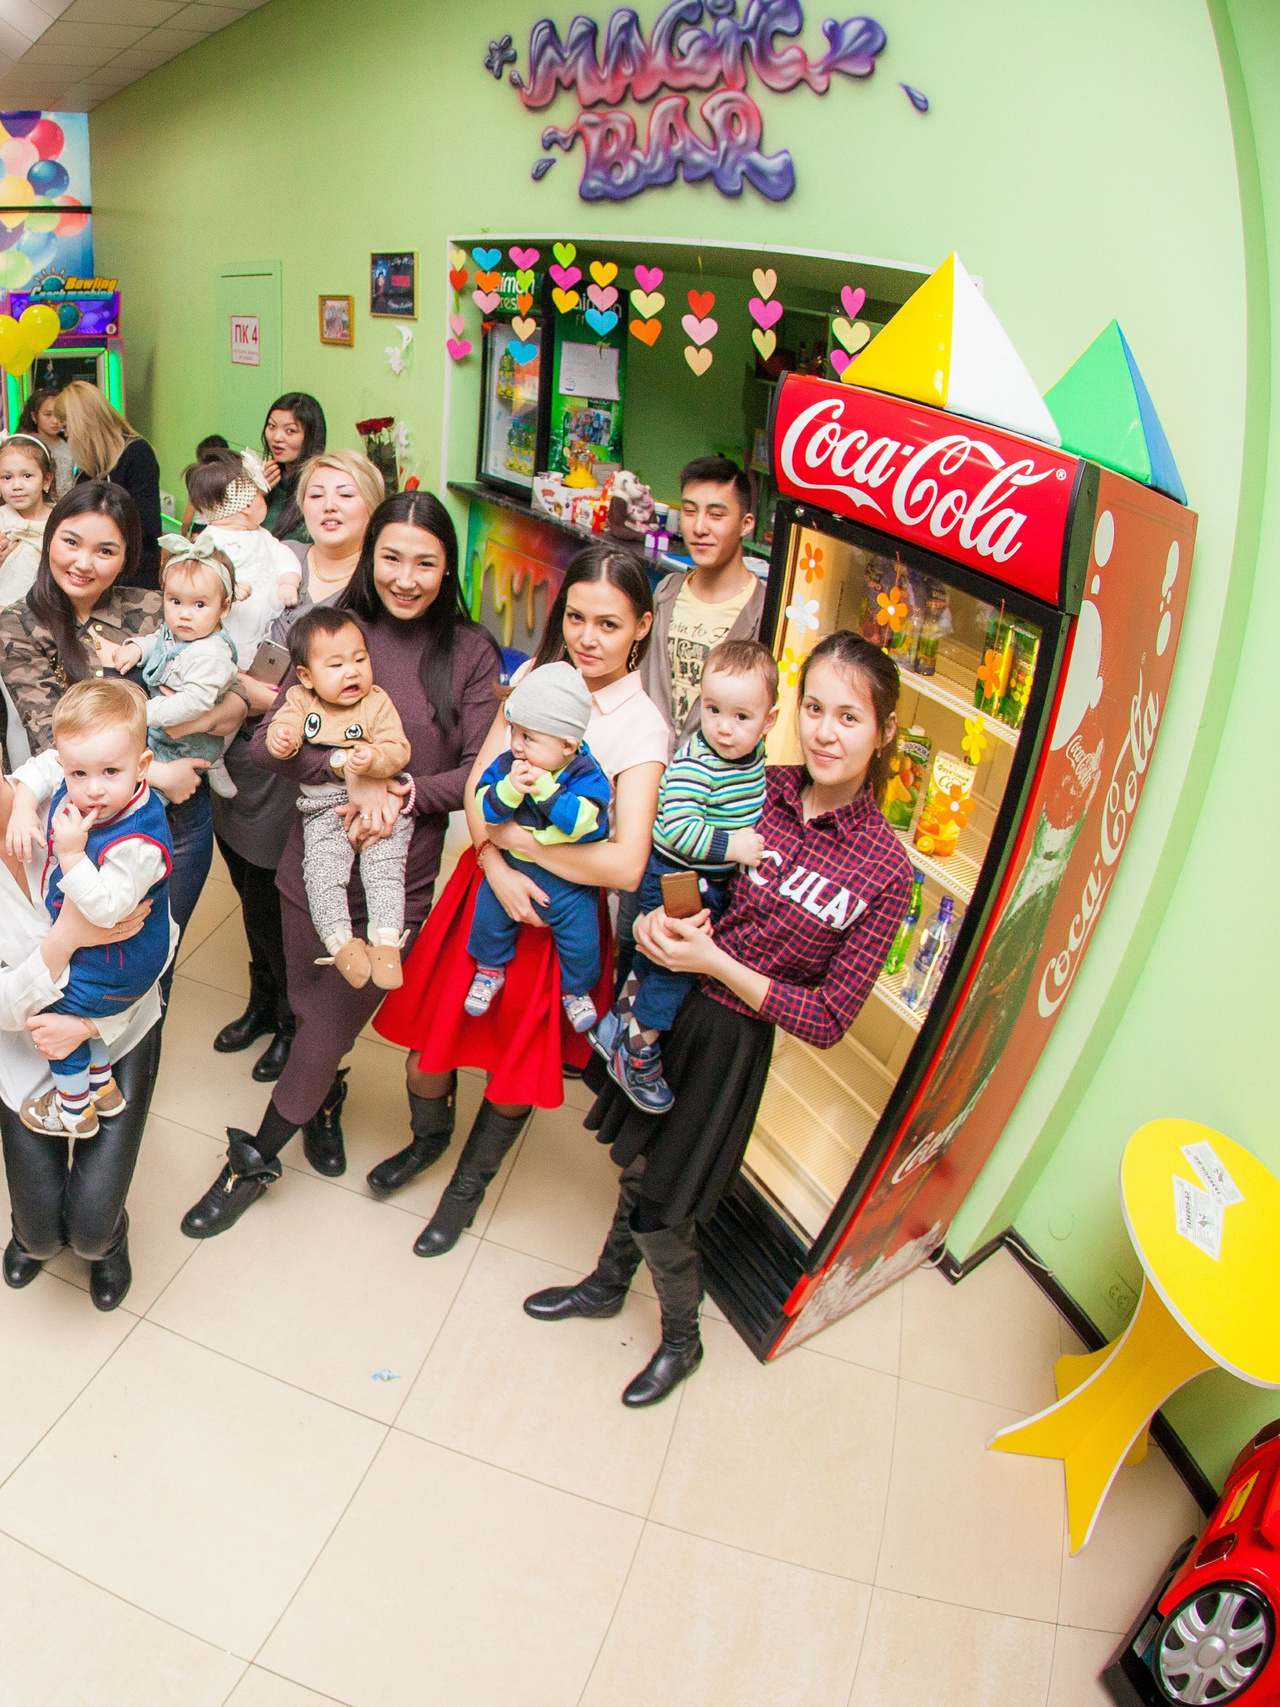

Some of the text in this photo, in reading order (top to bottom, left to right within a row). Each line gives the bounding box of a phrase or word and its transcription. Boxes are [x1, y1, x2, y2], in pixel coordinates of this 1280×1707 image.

[548, 88, 796, 202] BAR
[234, 323, 258, 345] ПК 4
[781, 398, 1055, 563] Coca-Cola
[1038, 668, 1159, 1018] Coca-Cola
